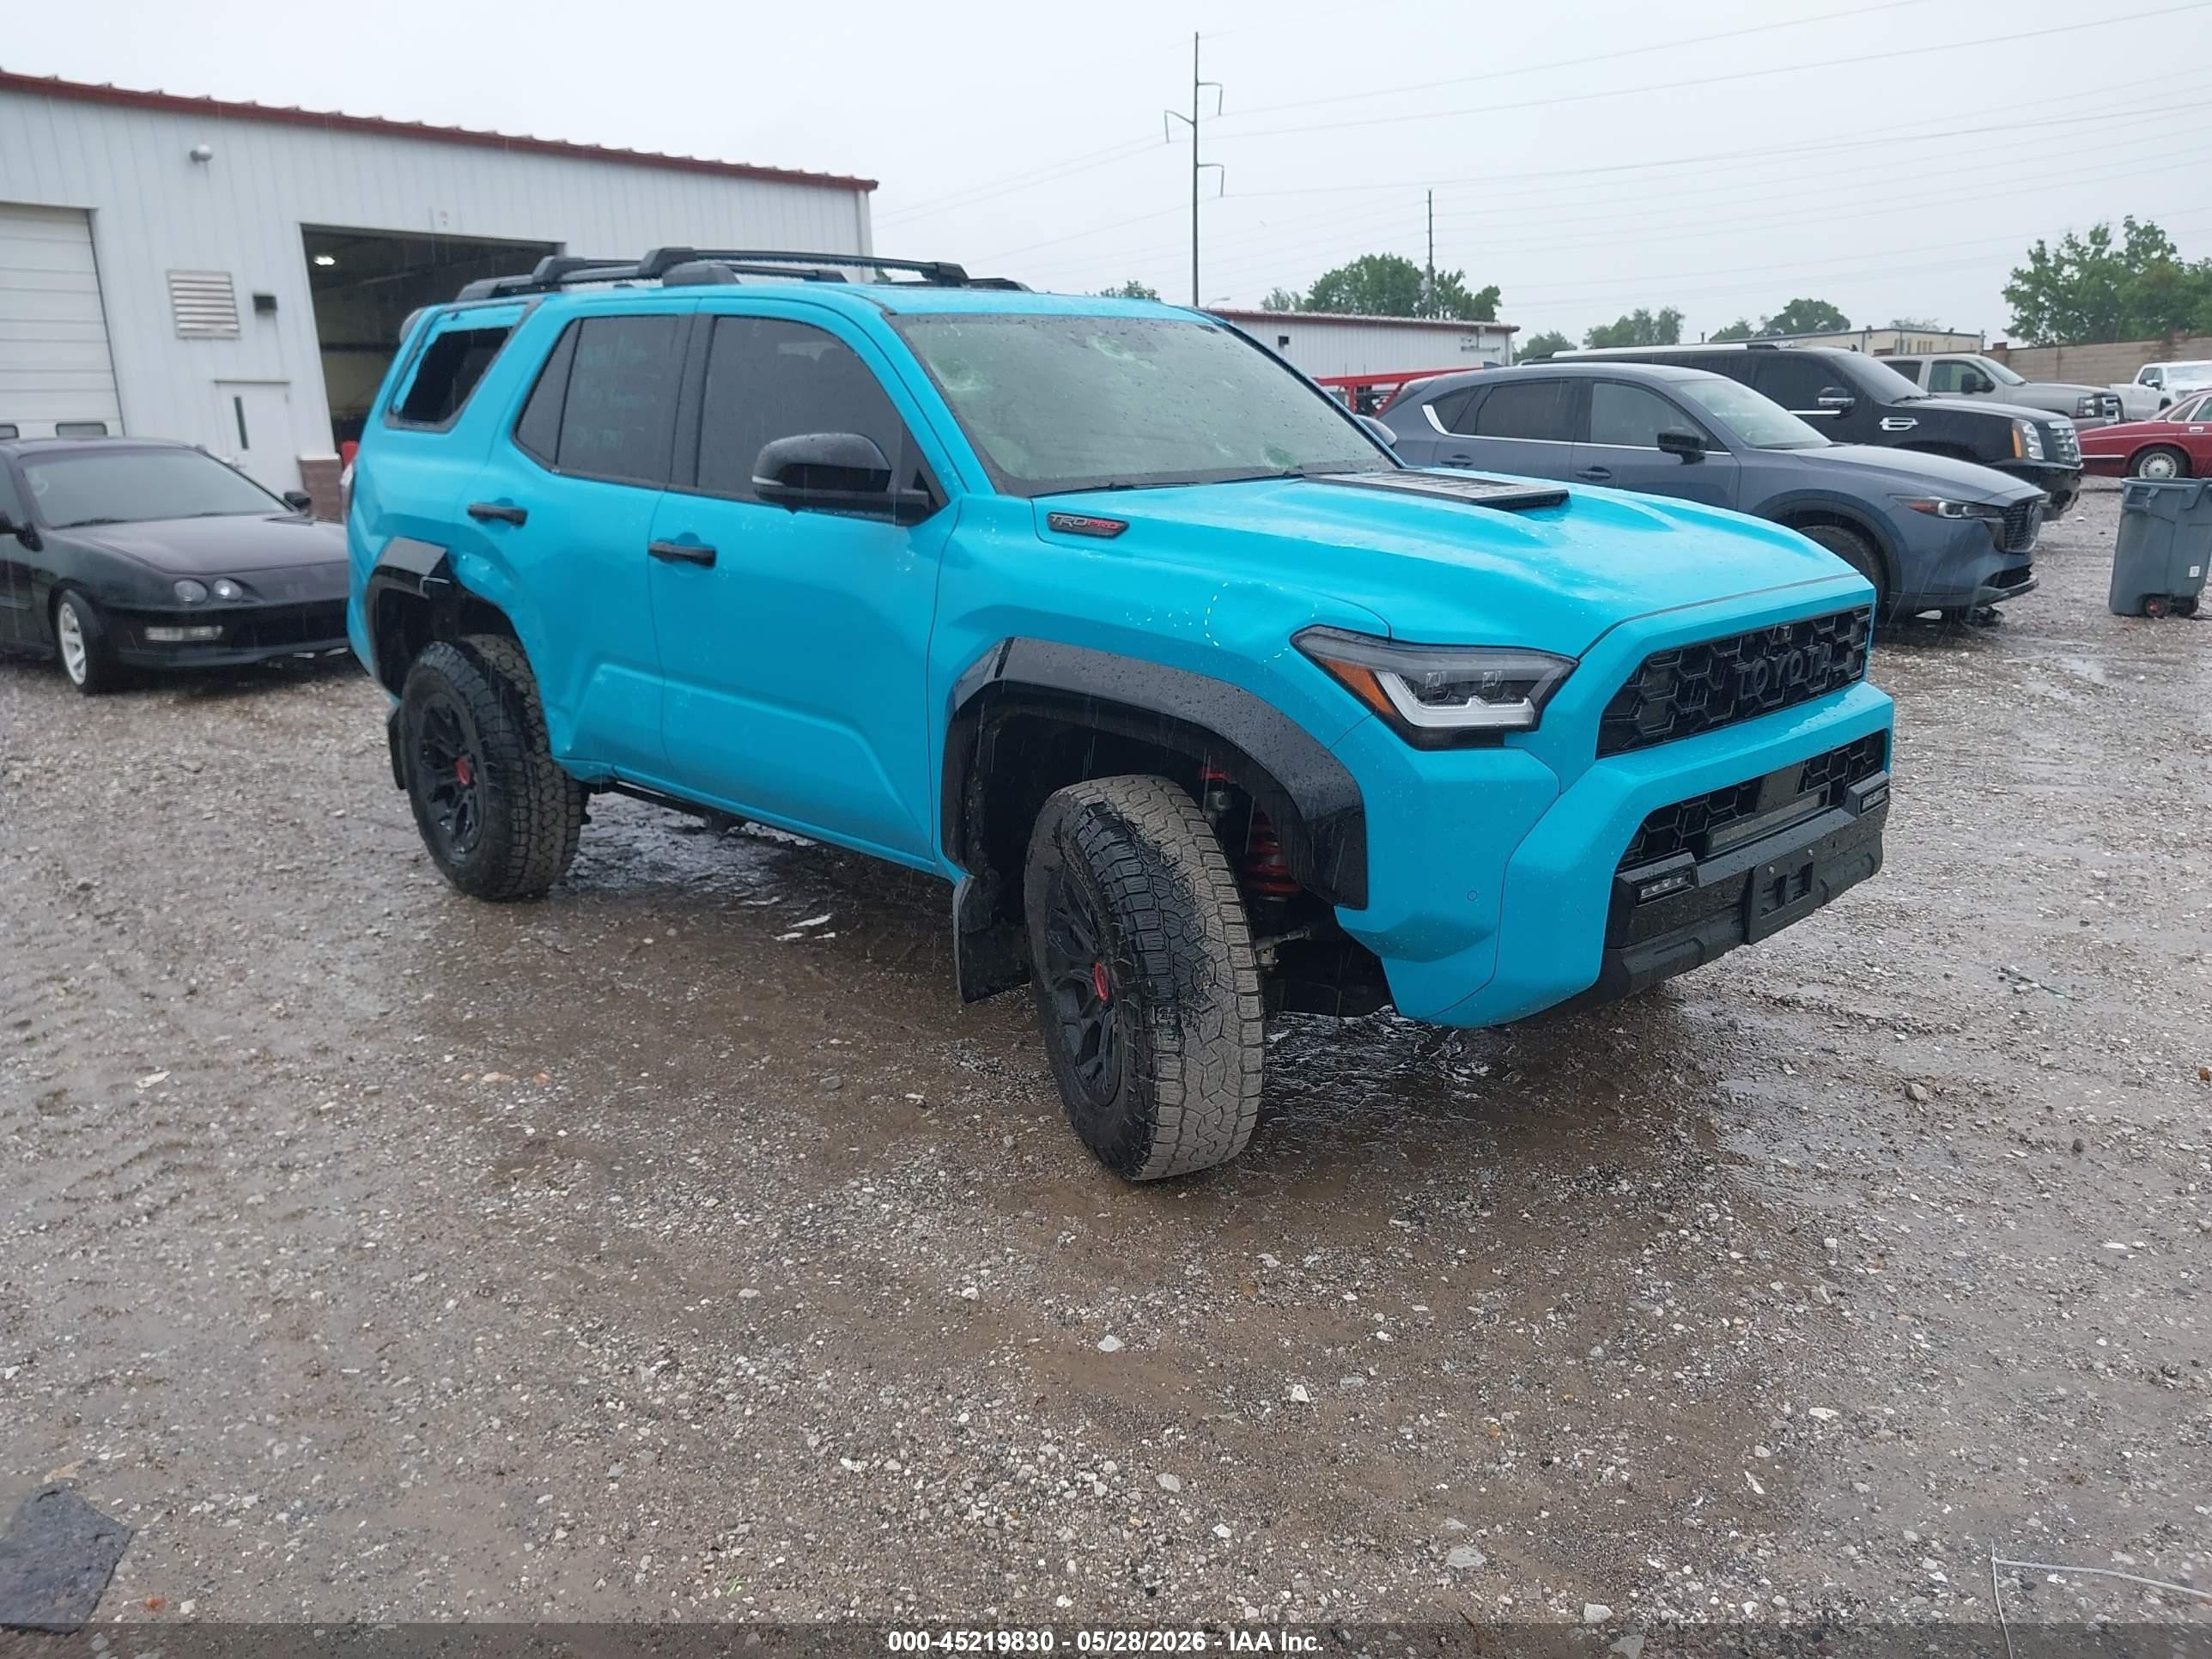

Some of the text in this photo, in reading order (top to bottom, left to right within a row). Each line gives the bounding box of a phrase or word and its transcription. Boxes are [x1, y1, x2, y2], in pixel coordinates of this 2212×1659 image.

[1051, 515, 1120, 530] TRD PRO
[1733, 642, 1832, 700] TOYOTA
